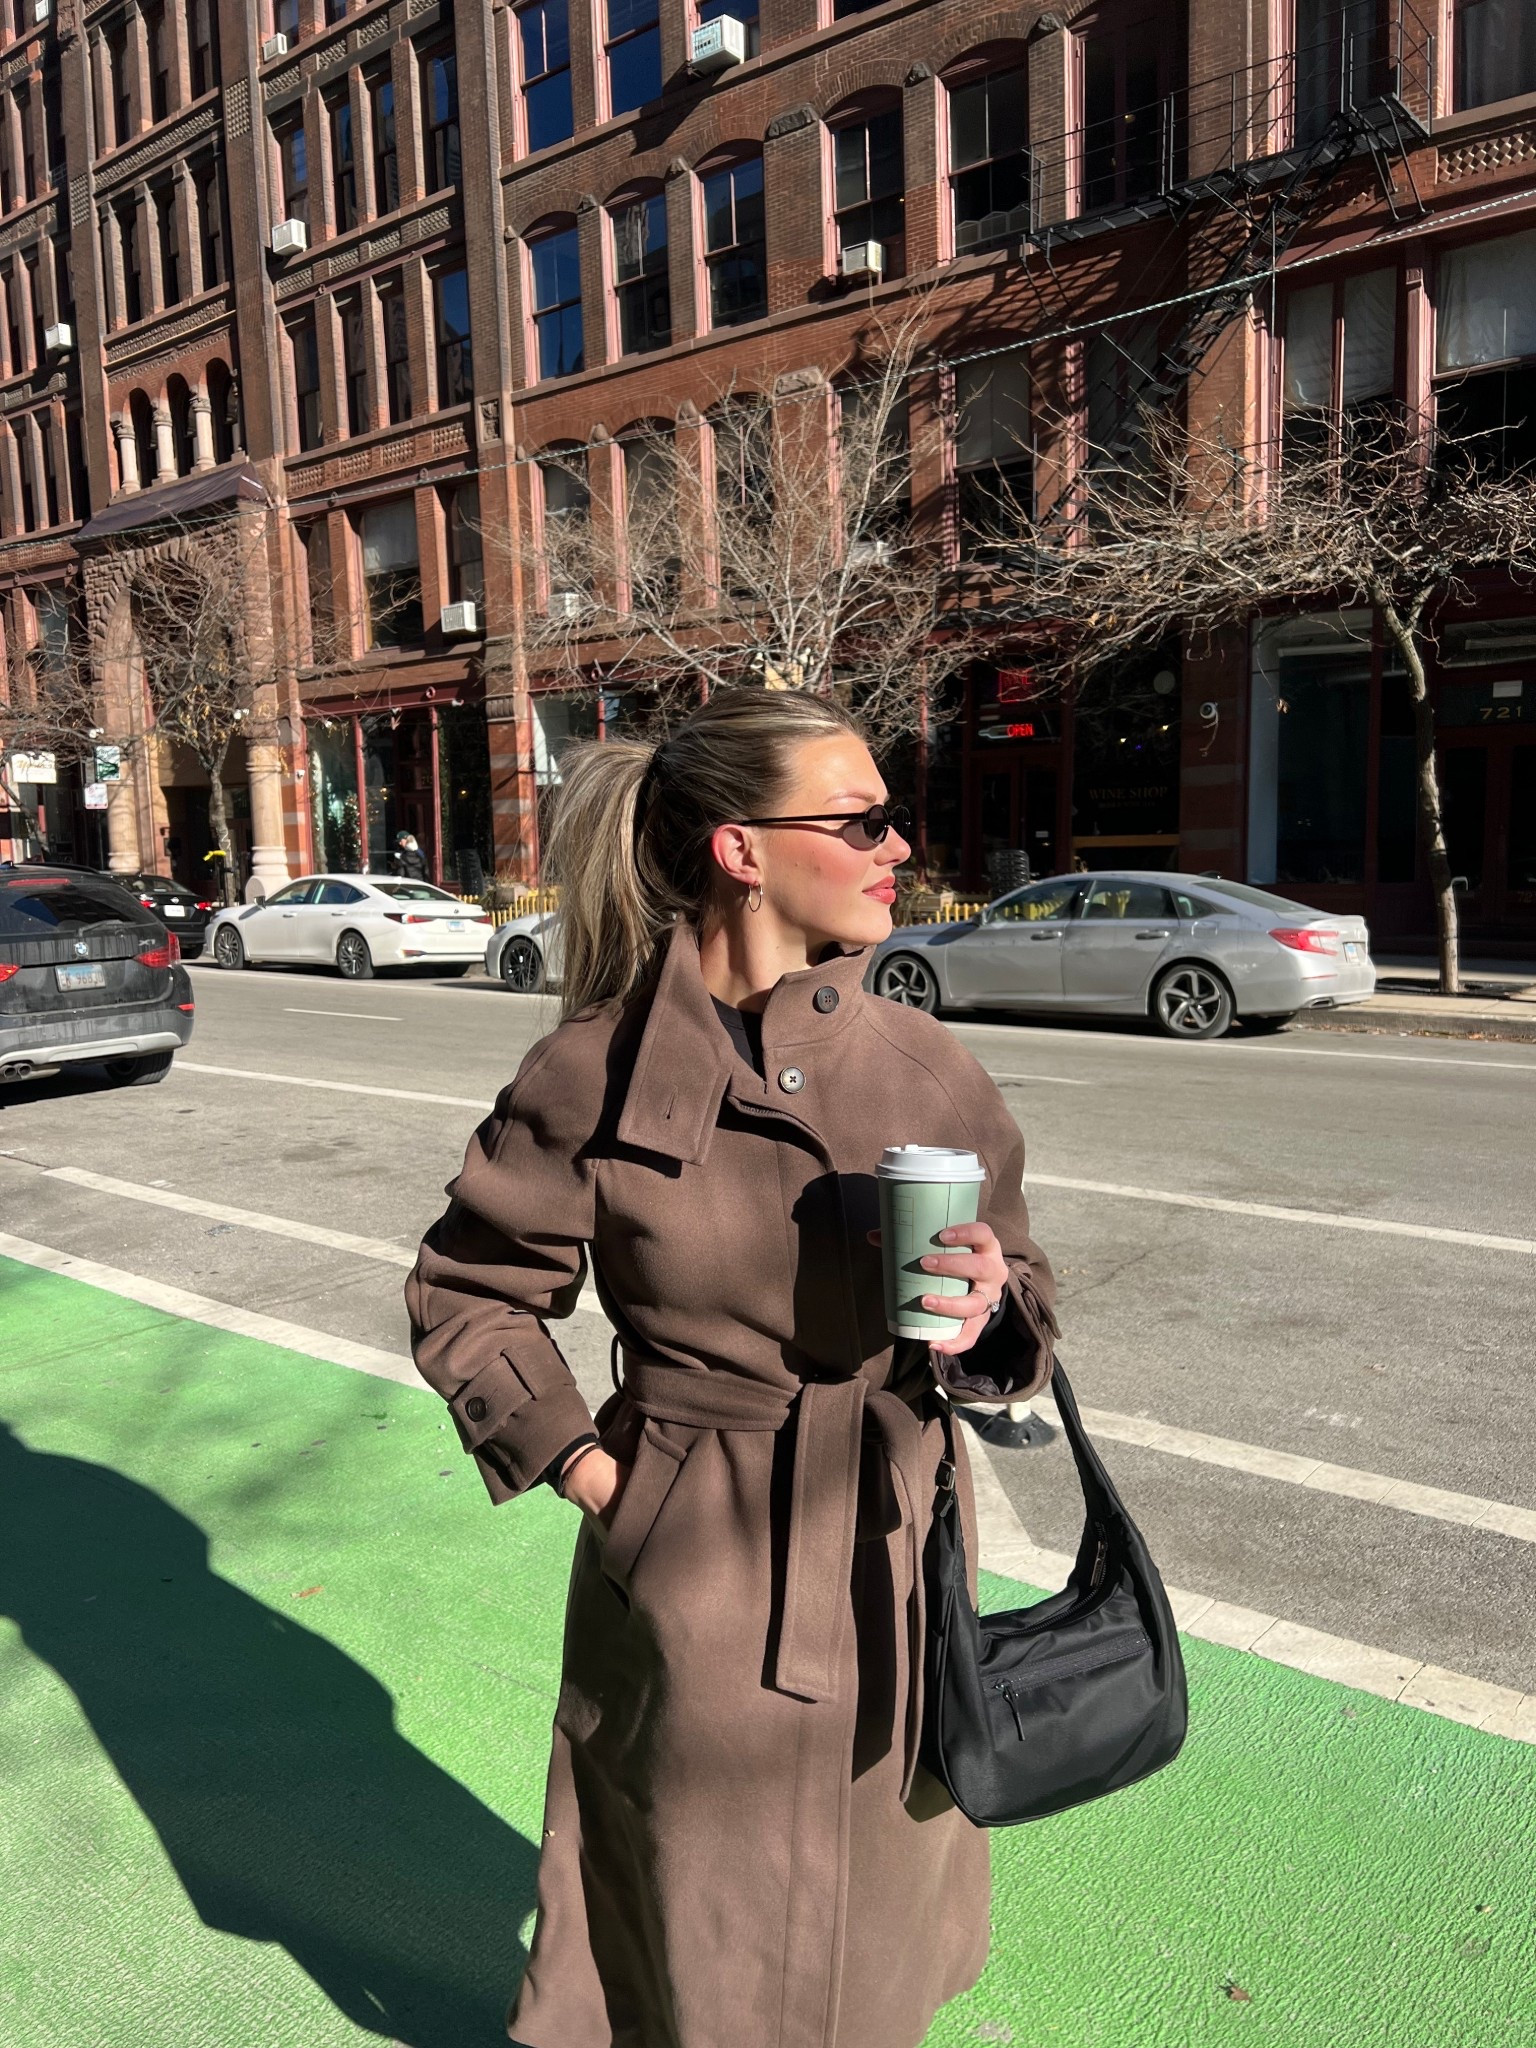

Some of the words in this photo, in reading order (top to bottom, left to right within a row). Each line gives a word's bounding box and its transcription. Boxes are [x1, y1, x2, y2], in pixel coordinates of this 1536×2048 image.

[1479, 705, 1522, 720] 721
[1007, 723, 1034, 737] OPEN
[1088, 787, 1126, 800] WINE
[1130, 786, 1169, 799] SHOP
[138, 938, 156, 947] X1
